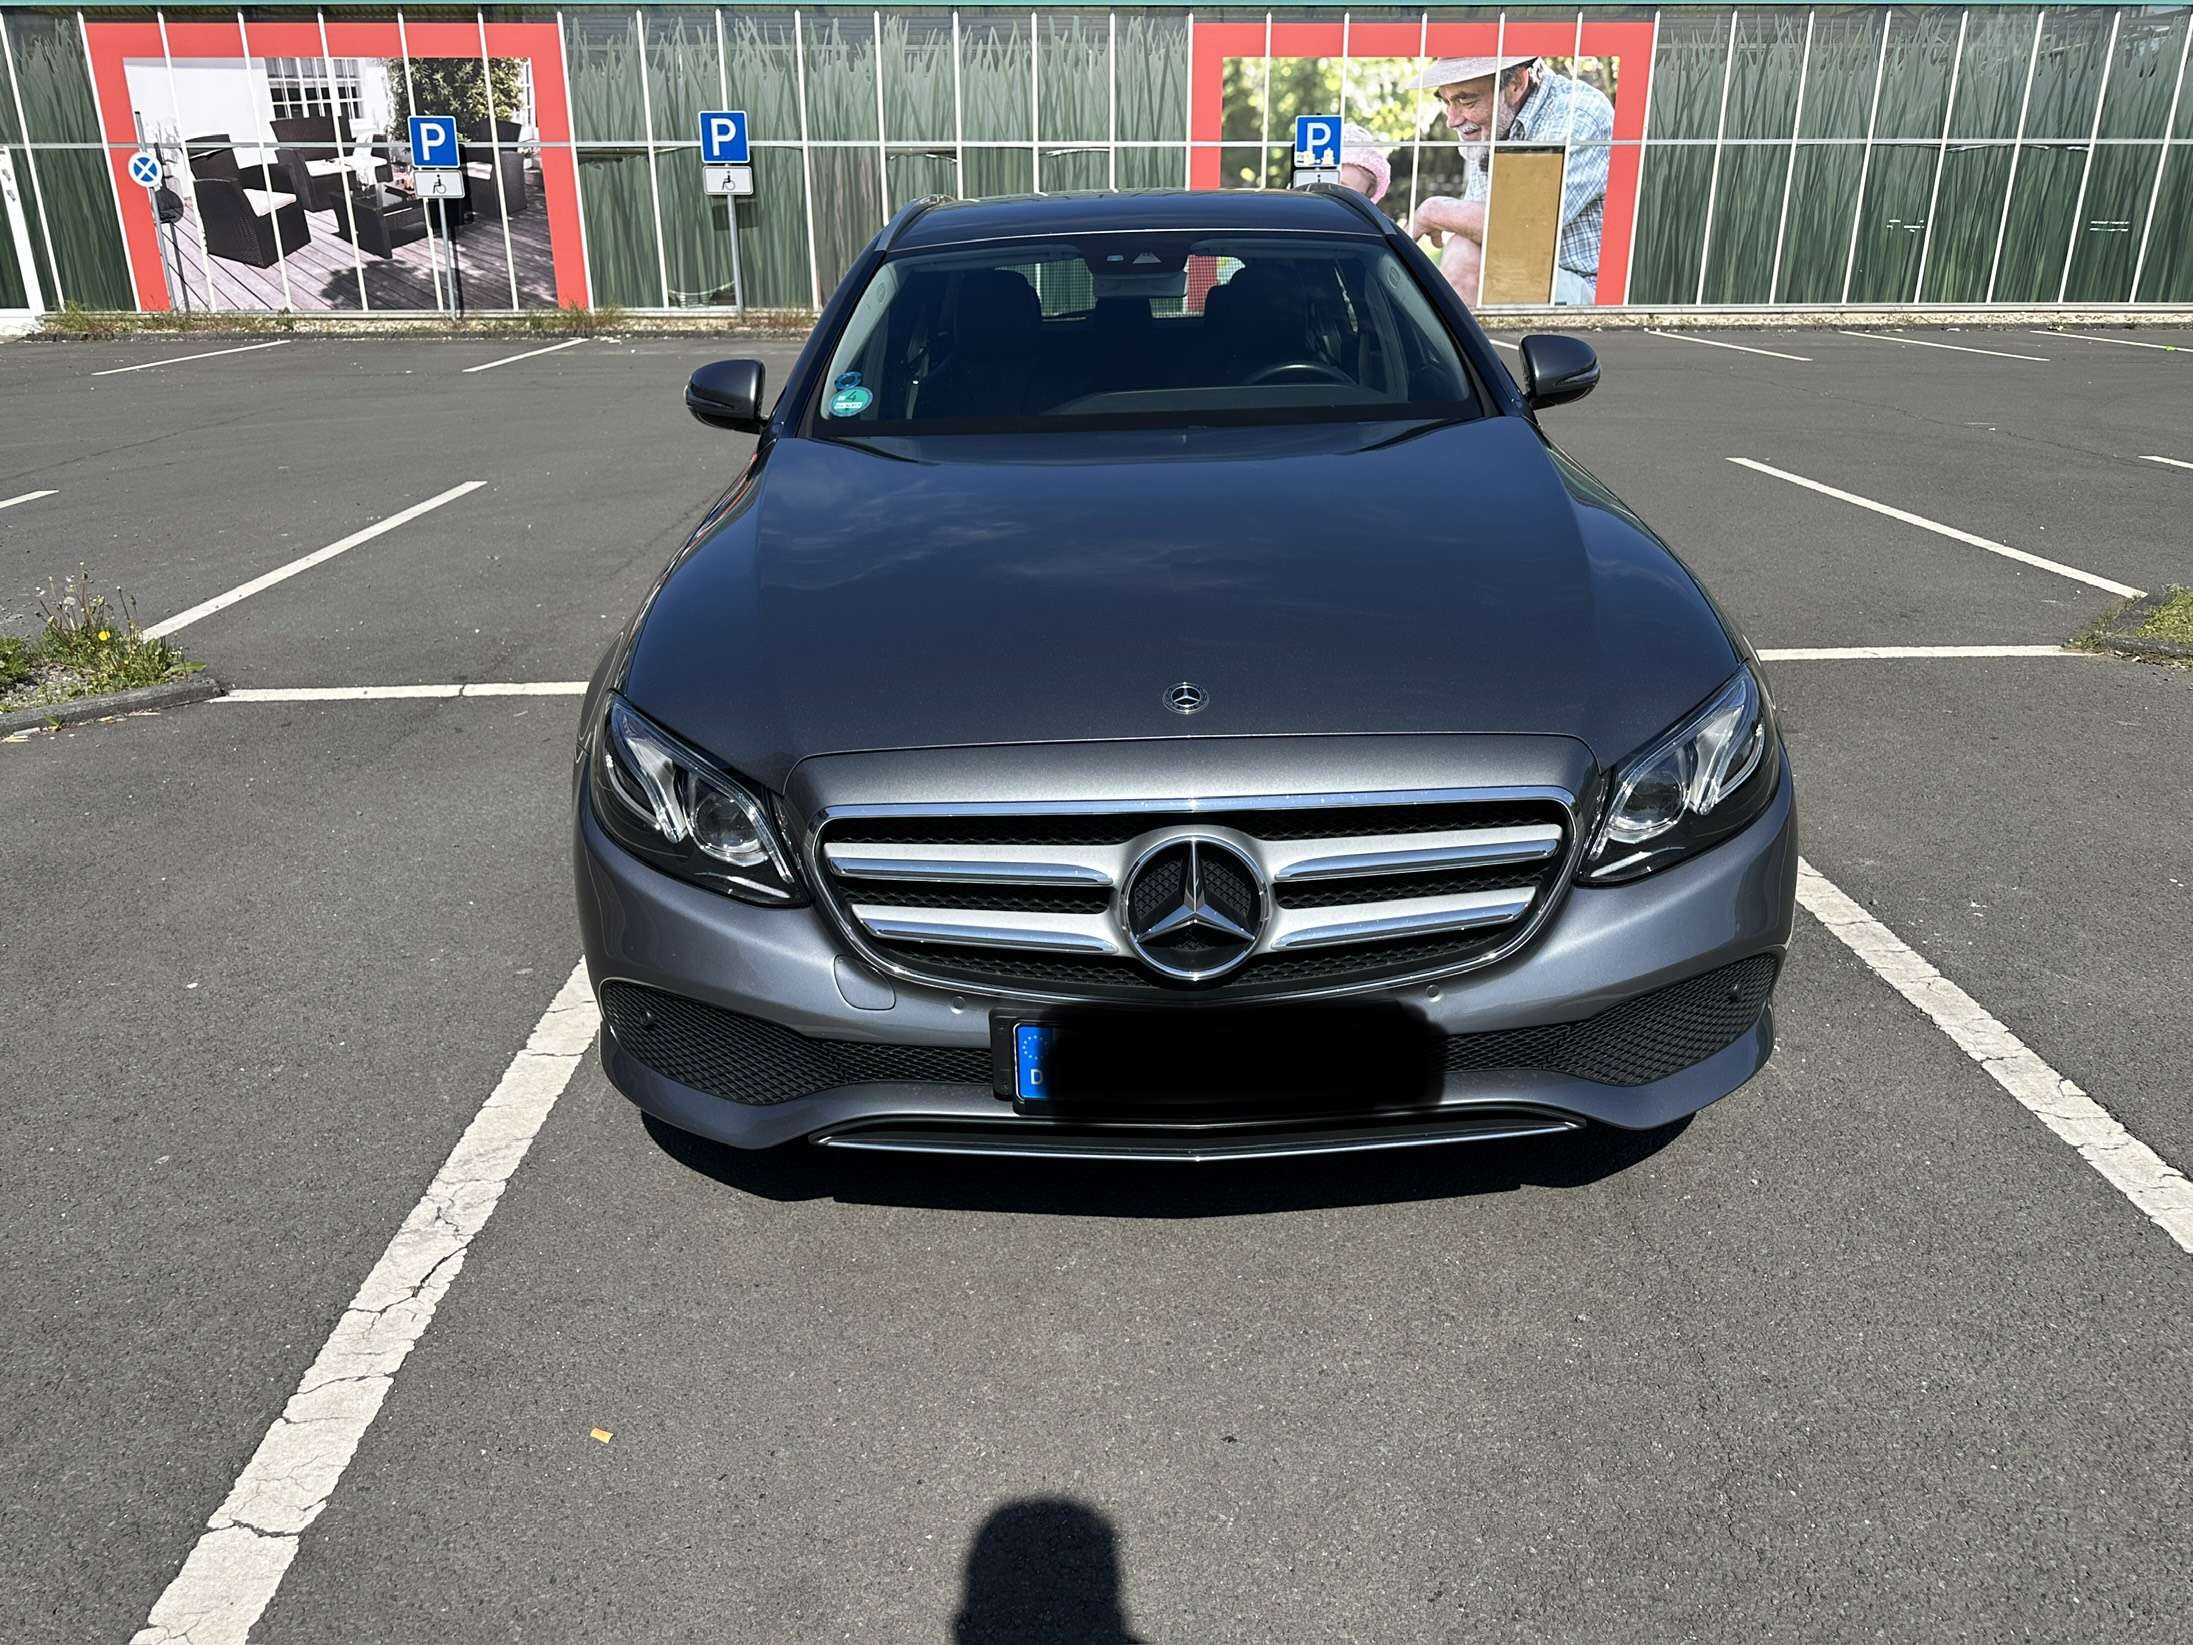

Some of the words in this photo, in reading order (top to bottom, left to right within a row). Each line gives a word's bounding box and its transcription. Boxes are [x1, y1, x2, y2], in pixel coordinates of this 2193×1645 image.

[420, 122, 445, 161] P
[710, 117, 736, 156] P
[1306, 122, 1332, 153] P
[846, 390, 857, 402] 4
[1030, 1068, 1044, 1085] D
